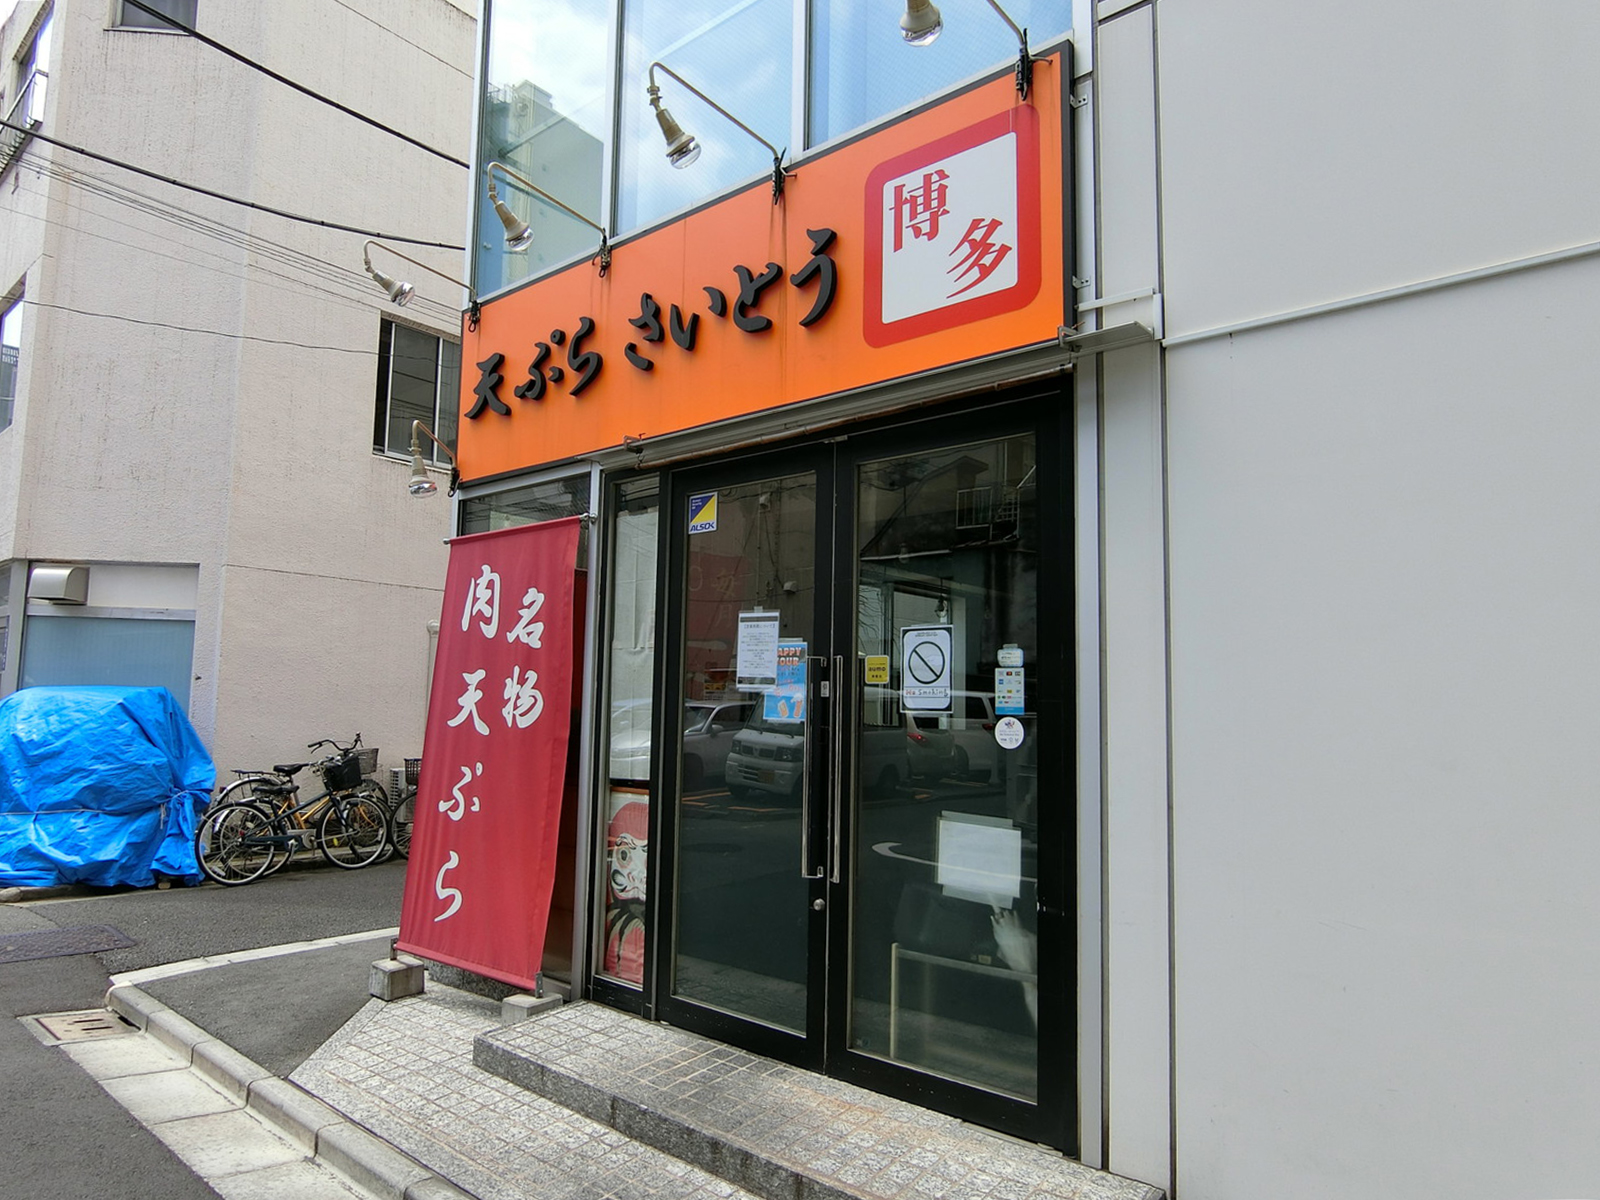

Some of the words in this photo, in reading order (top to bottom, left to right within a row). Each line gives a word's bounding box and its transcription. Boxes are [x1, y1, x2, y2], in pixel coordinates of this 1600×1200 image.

[889, 169, 1013, 299] 博多
[465, 316, 603, 420] 天ぷら
[624, 227, 838, 371] さいとう
[690, 521, 715, 532] ALSOK
[501, 587, 545, 729] 名物
[777, 647, 801, 656] APPY
[434, 564, 501, 923] 肉天ぷら
